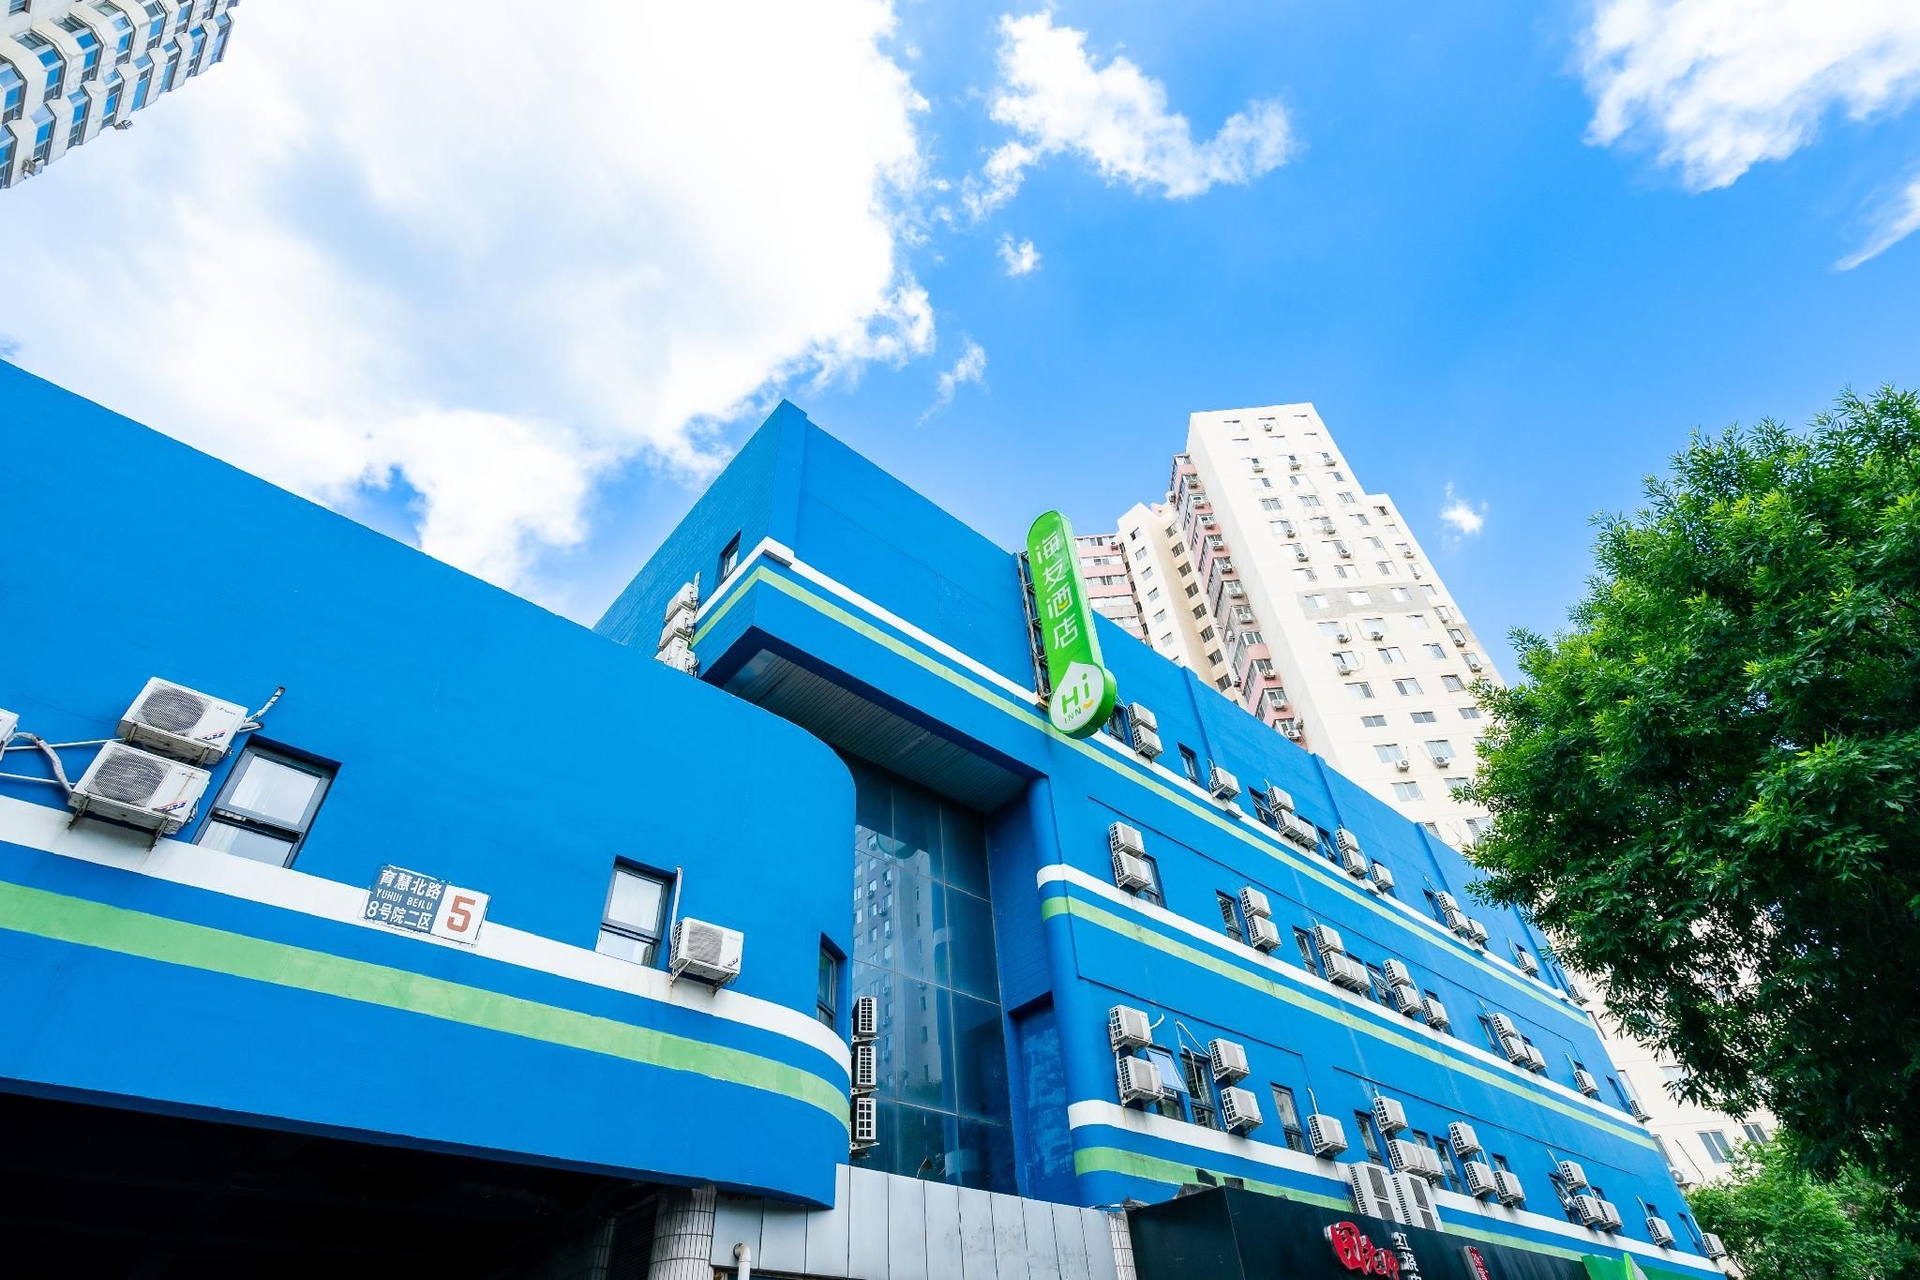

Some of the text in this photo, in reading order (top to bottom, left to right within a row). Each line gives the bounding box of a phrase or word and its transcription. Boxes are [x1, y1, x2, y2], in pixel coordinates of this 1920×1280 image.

[1035, 531, 1078, 650] 海友酒店
[1061, 673, 1090, 715] Hi
[1064, 707, 1082, 724] INN
[375, 887, 433, 911] YUHUI BEILU
[378, 868, 443, 900] 育慧北路
[366, 900, 433, 930] 8号院二区
[447, 895, 476, 933] 5
